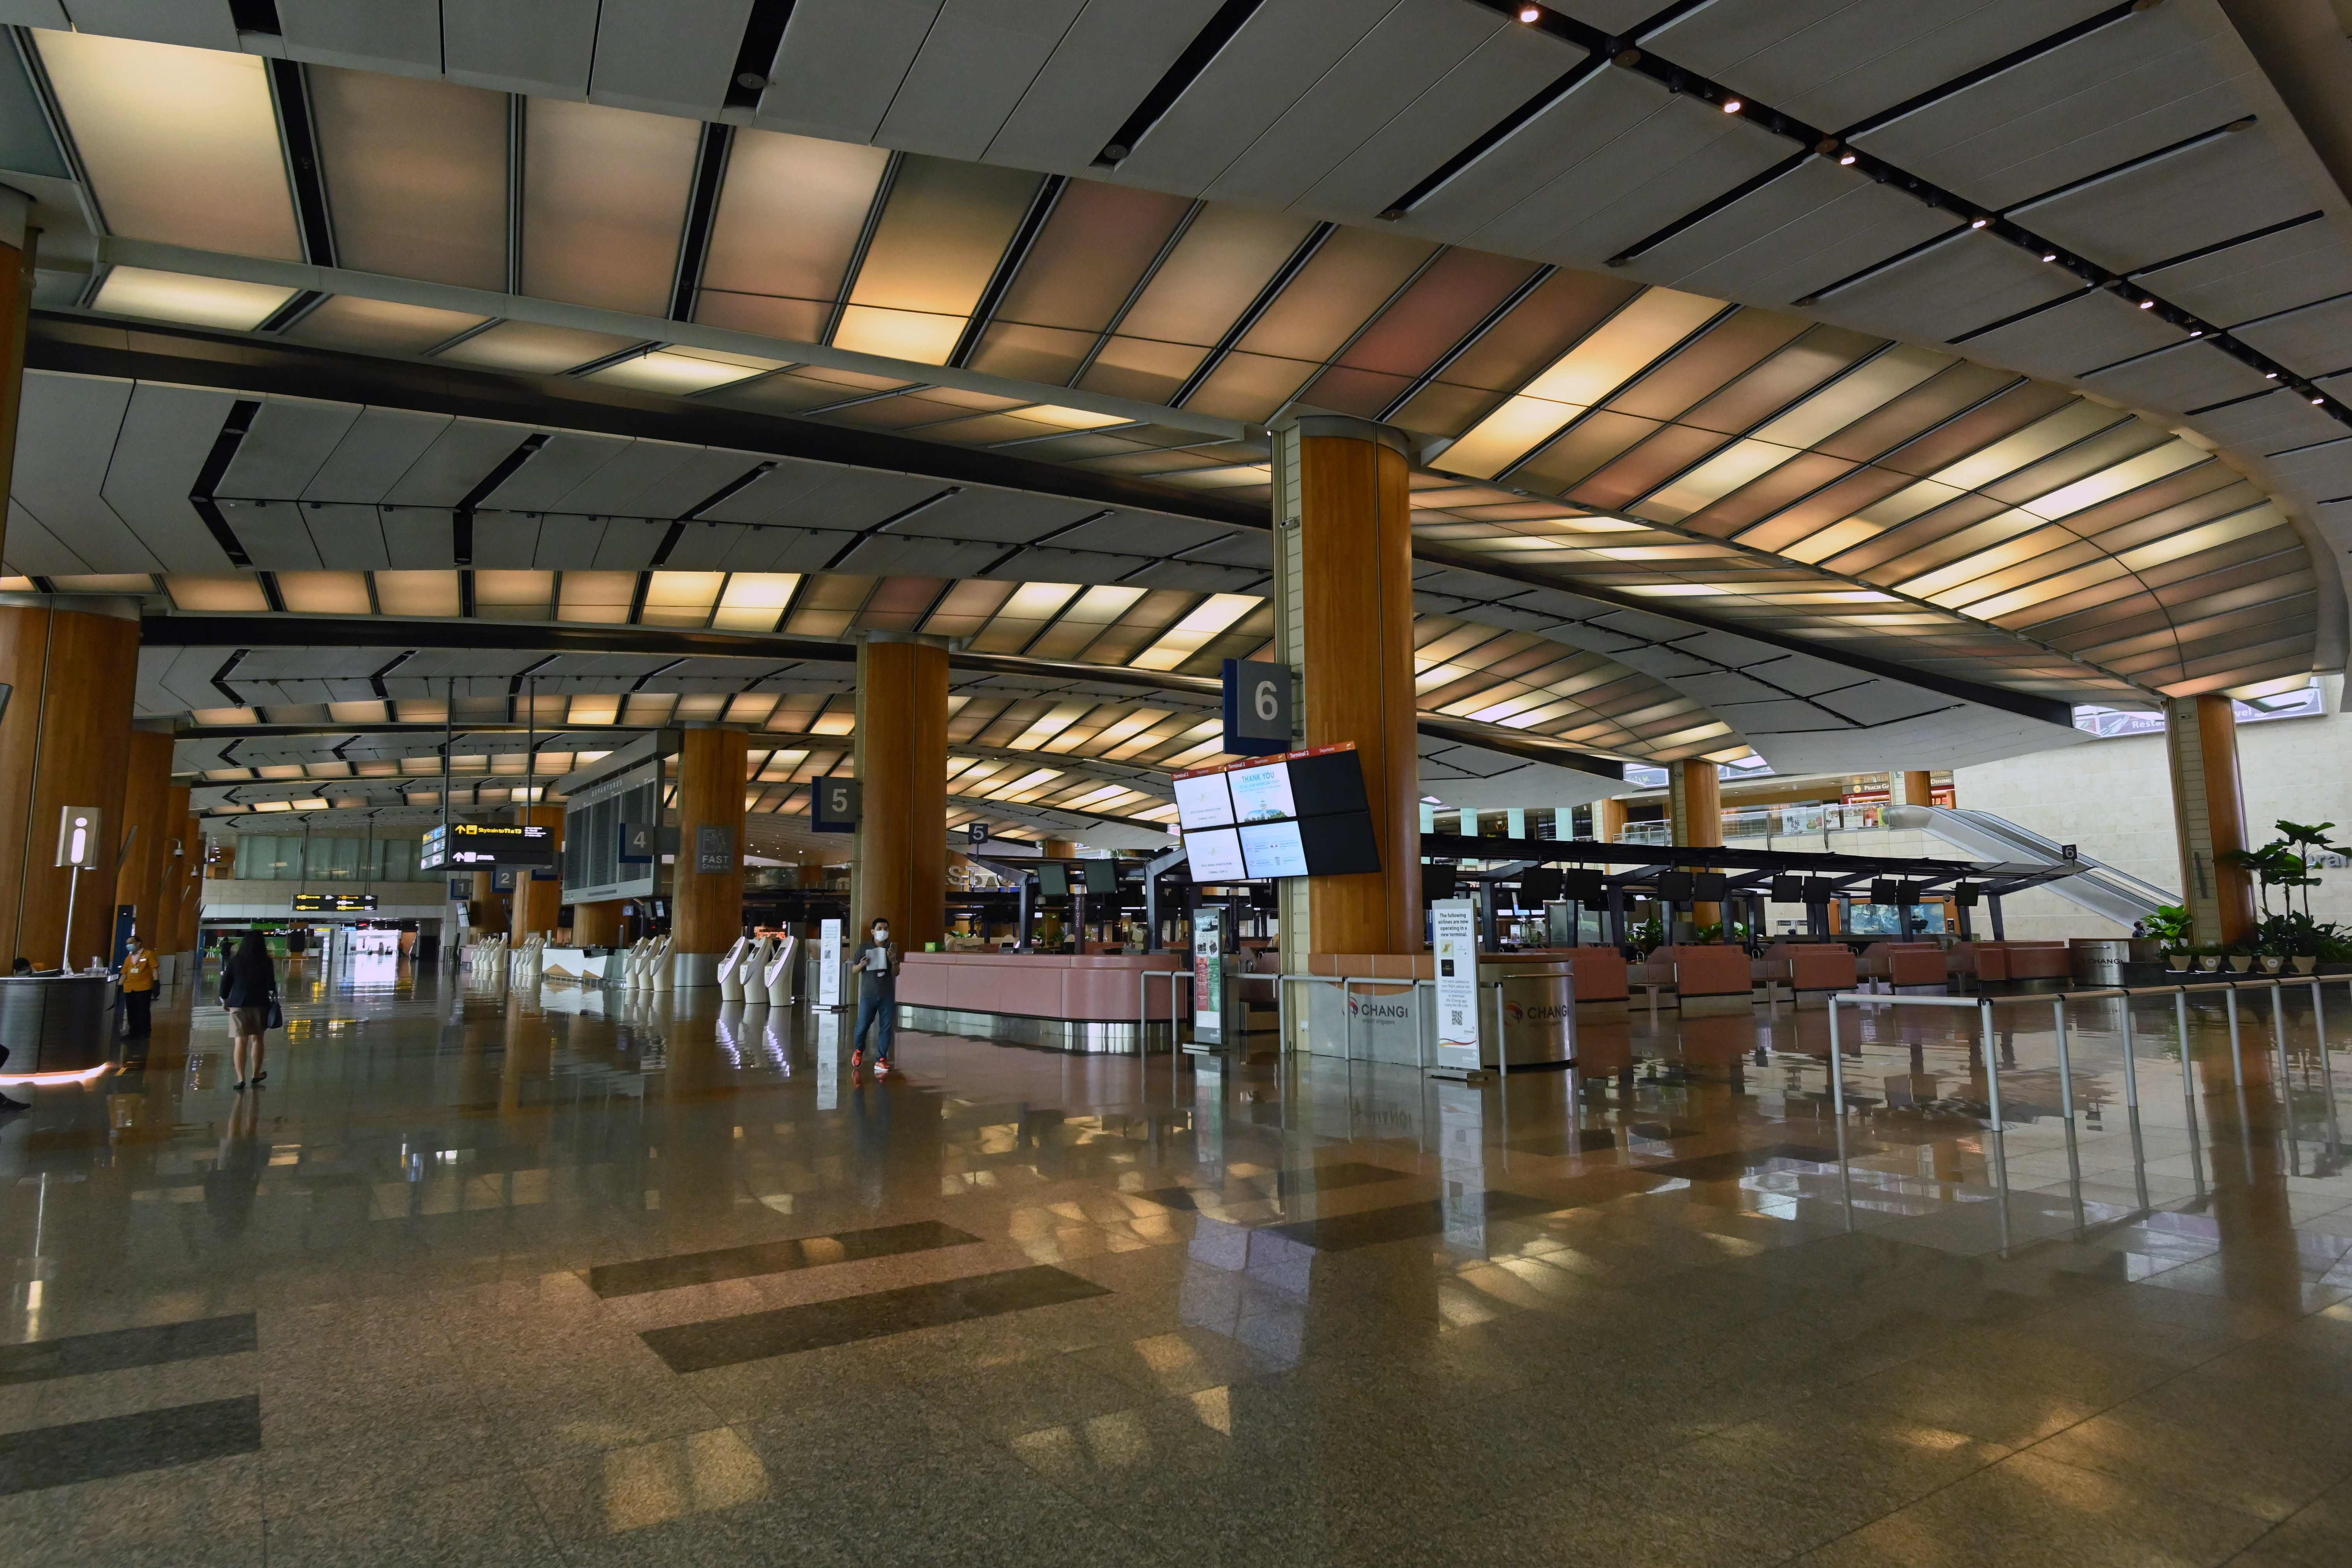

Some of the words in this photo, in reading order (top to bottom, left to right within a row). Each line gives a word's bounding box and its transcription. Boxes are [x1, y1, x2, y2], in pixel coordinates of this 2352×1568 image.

[1255, 680, 1278, 720] 6
[1241, 774, 1261, 783] THANK
[1262, 772, 1275, 780] YOU
[592, 779, 622, 797] DEPARTURES
[832, 788, 848, 812] 5
[634, 832, 646, 848] 4
[973, 825, 984, 841] 5
[702, 855, 729, 863] FAST
[2066, 847, 2074, 858] 6
[501, 874, 510, 884] 2
[459, 884, 464, 892] 1
[625, 906, 631, 915] 3
[1361, 1004, 1408, 1018] CHANGI
[1527, 1005, 1569, 1019] CHANGI
